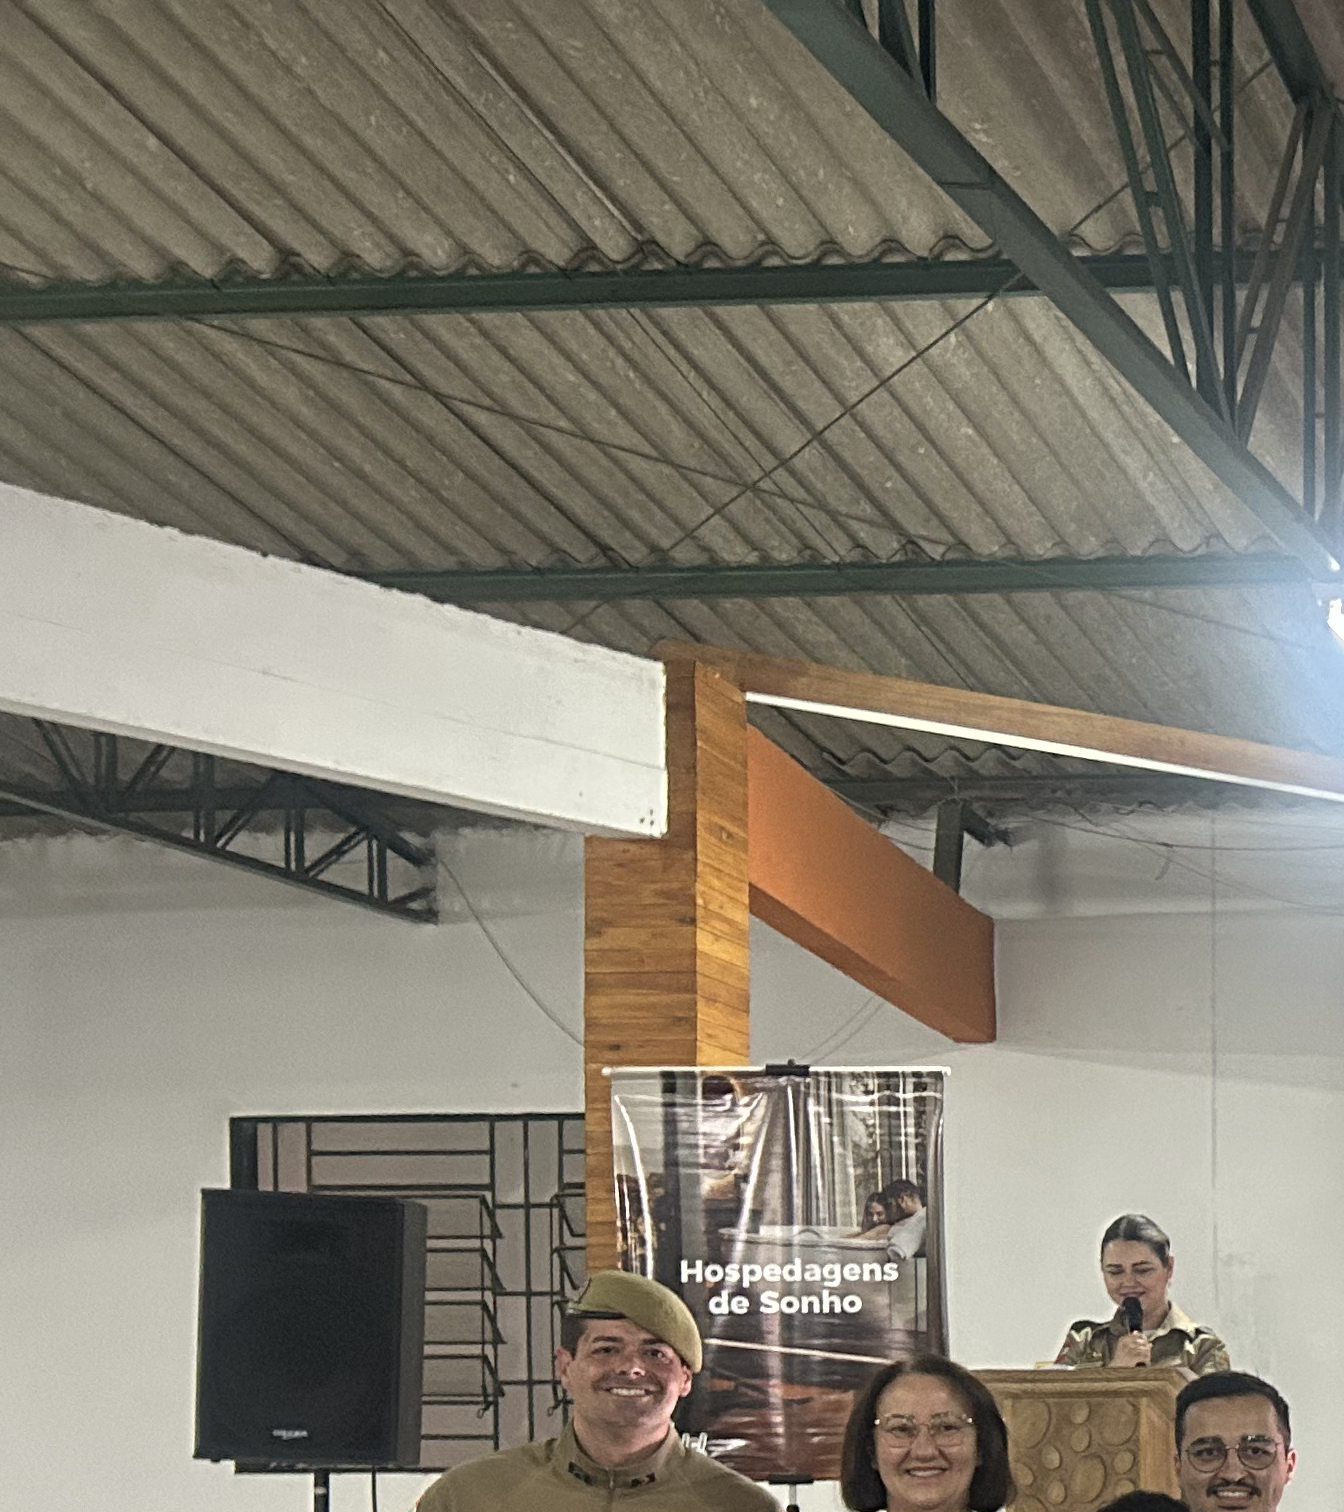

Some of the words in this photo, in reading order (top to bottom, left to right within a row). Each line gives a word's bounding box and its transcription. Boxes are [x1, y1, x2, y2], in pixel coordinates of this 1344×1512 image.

[680, 1258, 899, 1288] Hospedagens
[708, 1290, 749, 1315] de
[759, 1291, 862, 1315] Sonho
